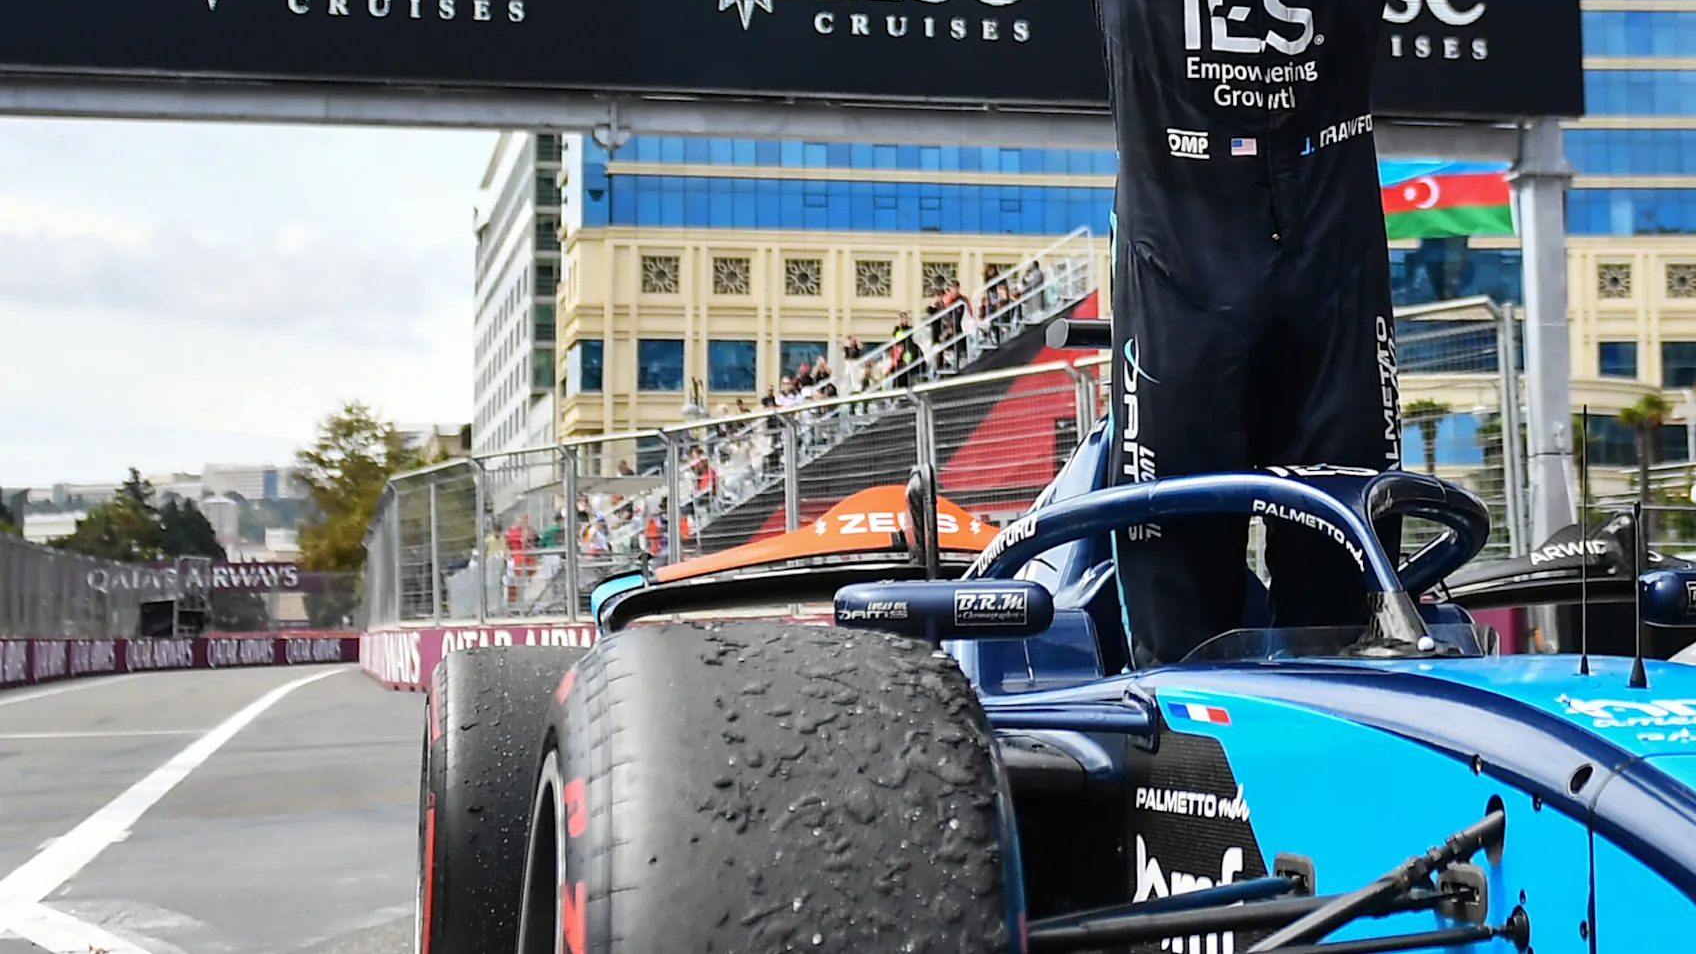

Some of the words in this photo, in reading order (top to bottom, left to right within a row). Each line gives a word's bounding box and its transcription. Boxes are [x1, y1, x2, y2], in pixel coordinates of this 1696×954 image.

[812, 12, 1031, 42] CRUISES
[1390, 34, 1489, 60] ISES
[1167, 135, 1210, 155] OMP
[837, 512, 960, 535] ZES
[1252, 499, 1346, 545] PALMETTO
[1136, 786, 1217, 818] PALMETTO
